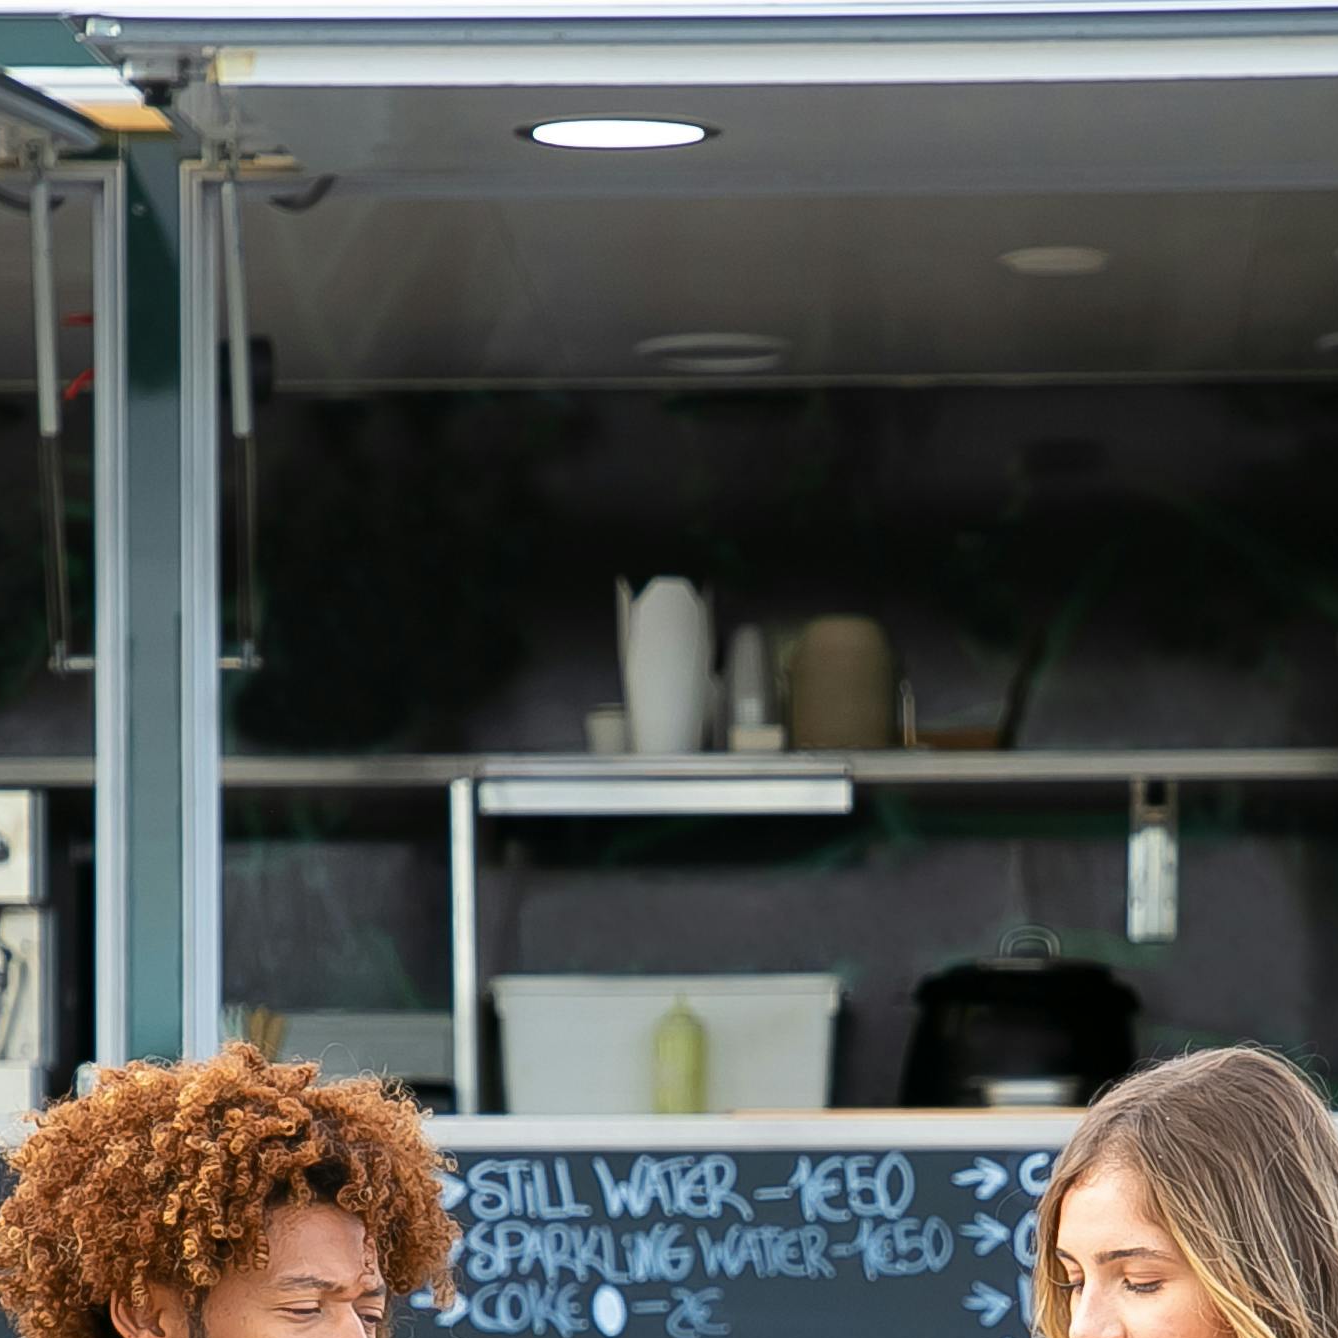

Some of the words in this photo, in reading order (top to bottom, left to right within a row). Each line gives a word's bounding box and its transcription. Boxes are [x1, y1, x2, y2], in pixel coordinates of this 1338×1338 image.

[592, 1154, 754, 1222] WATER
[695, 1222, 837, 1280] WATER
[469, 1280, 589, 1338] COKE
